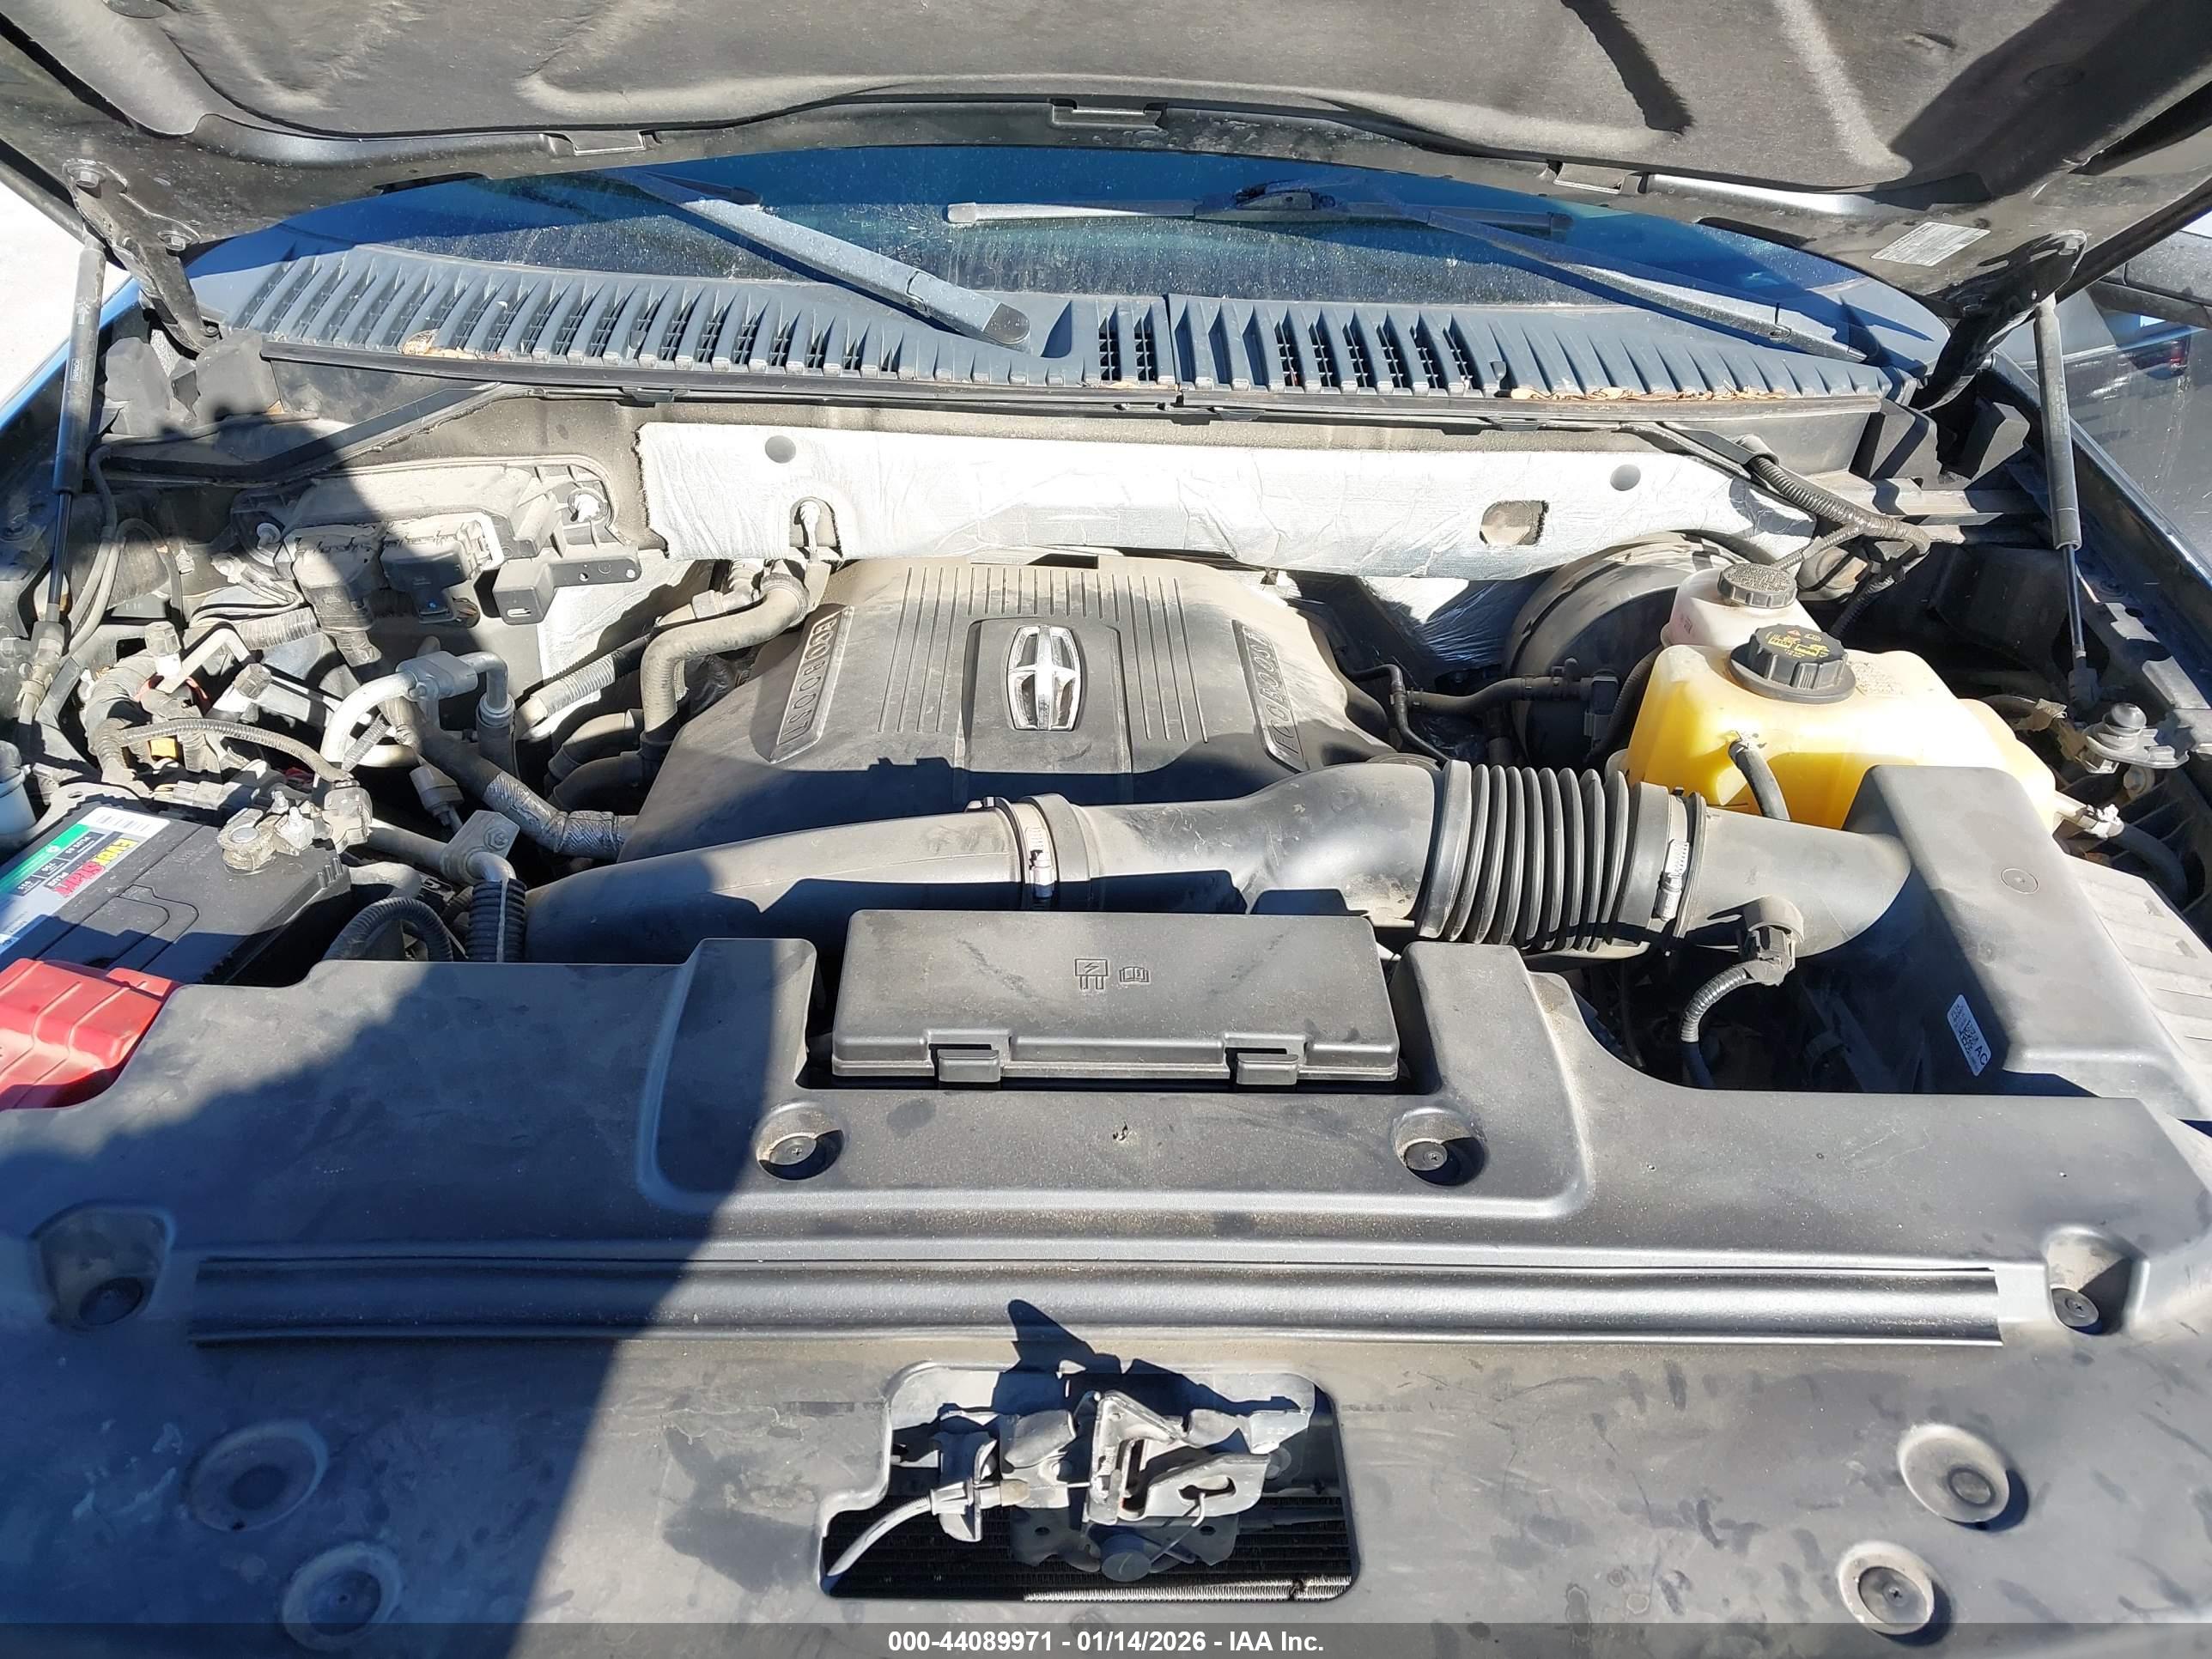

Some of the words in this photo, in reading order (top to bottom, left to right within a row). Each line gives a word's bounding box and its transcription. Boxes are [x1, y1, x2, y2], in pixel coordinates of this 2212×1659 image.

[54, 837, 139, 899] EverStart
[46, 872, 69, 887] PLUS
[1975, 1046, 1988, 1066] AC
